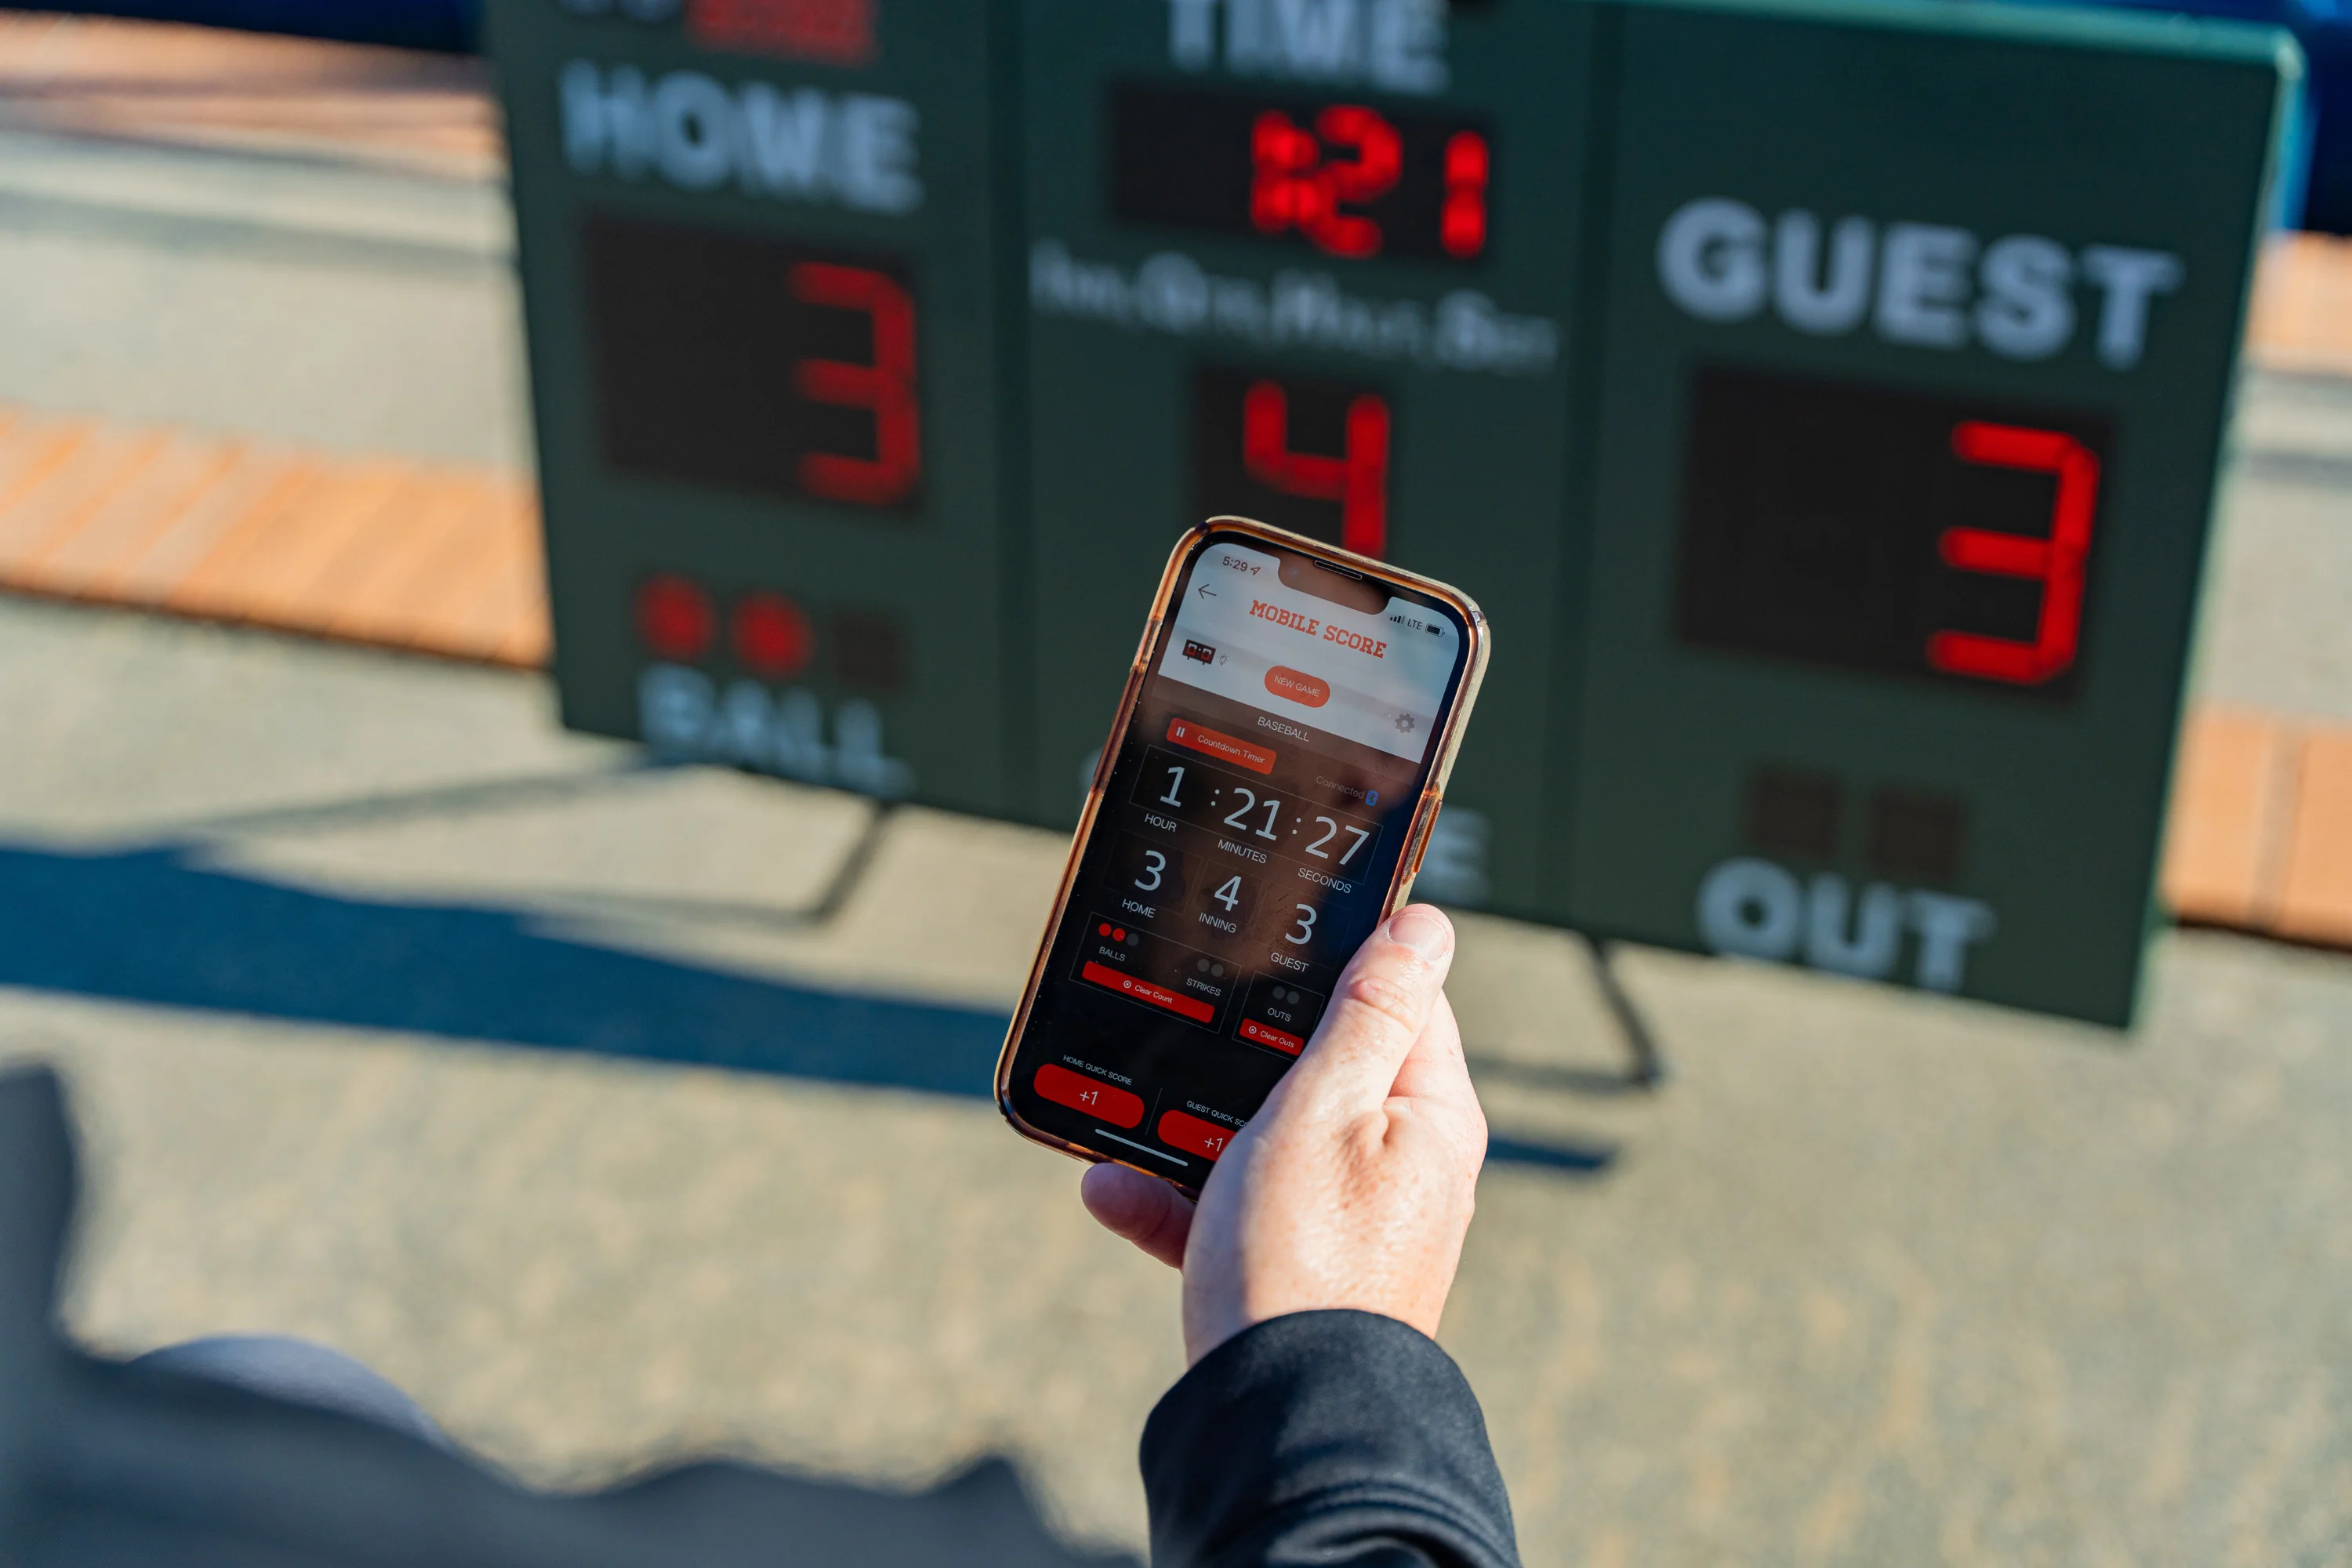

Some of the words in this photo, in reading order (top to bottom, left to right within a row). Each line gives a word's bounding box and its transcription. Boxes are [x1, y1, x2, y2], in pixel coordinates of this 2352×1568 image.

[1657, 198, 2184, 370] GUEST
[790, 261, 922, 506] 3
[1244, 379, 1389, 559] 4
[1222, 556, 1248, 572] 5:29
[1926, 420, 2100, 686] 3
[1249, 600, 1320, 636] MOBILE
[1323, 625, 1387, 659] SCORE
[1407, 619, 1423, 630] LTE
[1273, 676, 1294, 688] NEW
[1295, 683, 1321, 697] GAME
[1257, 717, 1309, 742] BASEBALL
[1197, 735, 1240, 756] Countdown
[1243, 750, 1265, 764] Timer
[1316, 775, 1366, 800] Connected
[1145, 813, 1177, 833] HOUR
[1218, 839, 1267, 864] MINUTES
[1134, 849, 1167, 891] 3
[1298, 867, 1352, 894] SECONDS
[1214, 875, 1242, 912] 4
[1122, 898, 1156, 919] HOME
[1199, 912, 1237, 934] INNING
[1284, 903, 1317, 945] 3
[1697, 857, 1997, 993] OUT
[1098, 946, 1127, 963] BALLS
[1271, 953, 1309, 972] GUEST
[1134, 985, 1152, 996] Clear
[1152, 991, 1174, 1004] Count
[1186, 978, 1221, 997] STRIKES
[1267, 1007, 1292, 1022] OUTS
[1260, 1030, 1278, 1042] Clear
[1279, 1037, 1295, 1049] Outs
[1063, 1054, 1083, 1069] HOME
[1085, 1062, 1107, 1076] QUICK
[1108, 1071, 1133, 1085] SCORE
[1080, 1091, 1098, 1105] +1
[1186, 1100, 1211, 1114] GUEST
[1211, 1109, 1234, 1123] QUICK
[1204, 1138, 1223, 1152] +1
